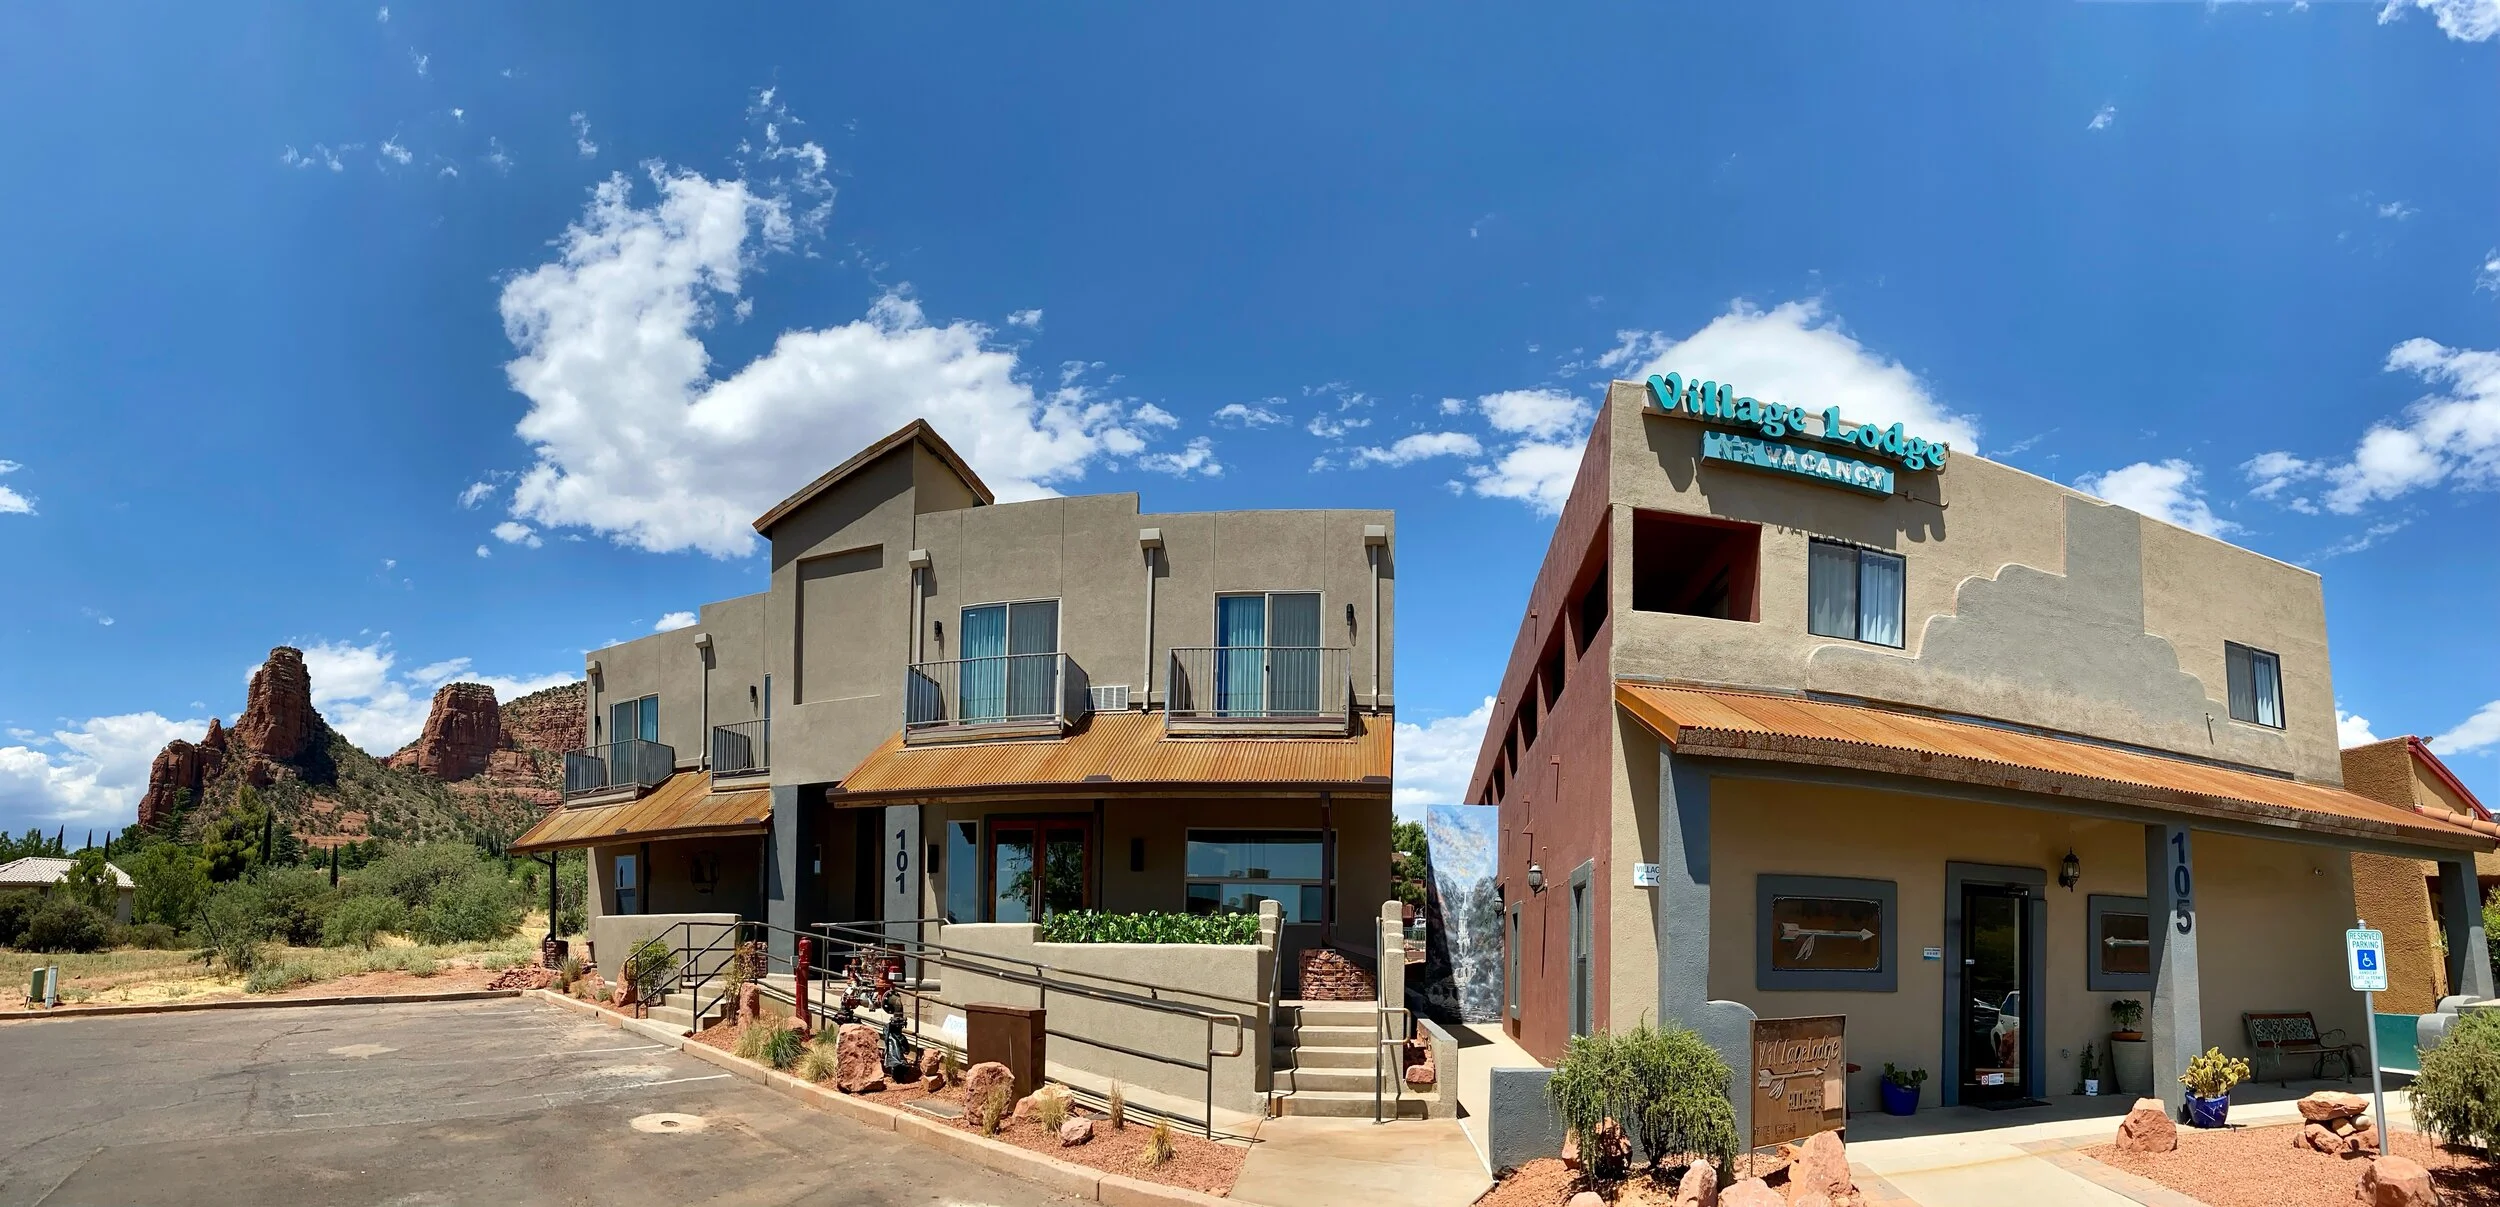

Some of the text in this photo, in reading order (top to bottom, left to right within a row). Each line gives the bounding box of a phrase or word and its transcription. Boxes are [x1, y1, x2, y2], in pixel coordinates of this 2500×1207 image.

[1646, 372, 1946, 471] Village Lodge
[1766, 446, 1885, 489] VACANCY
[896, 829, 908, 894] 101
[2172, 832, 2192, 935] 105
[2349, 932, 2380, 941] RESERVED
[2352, 940, 2379, 949] PARKING
[1758, 1034, 1839, 1073] Village Lodge
